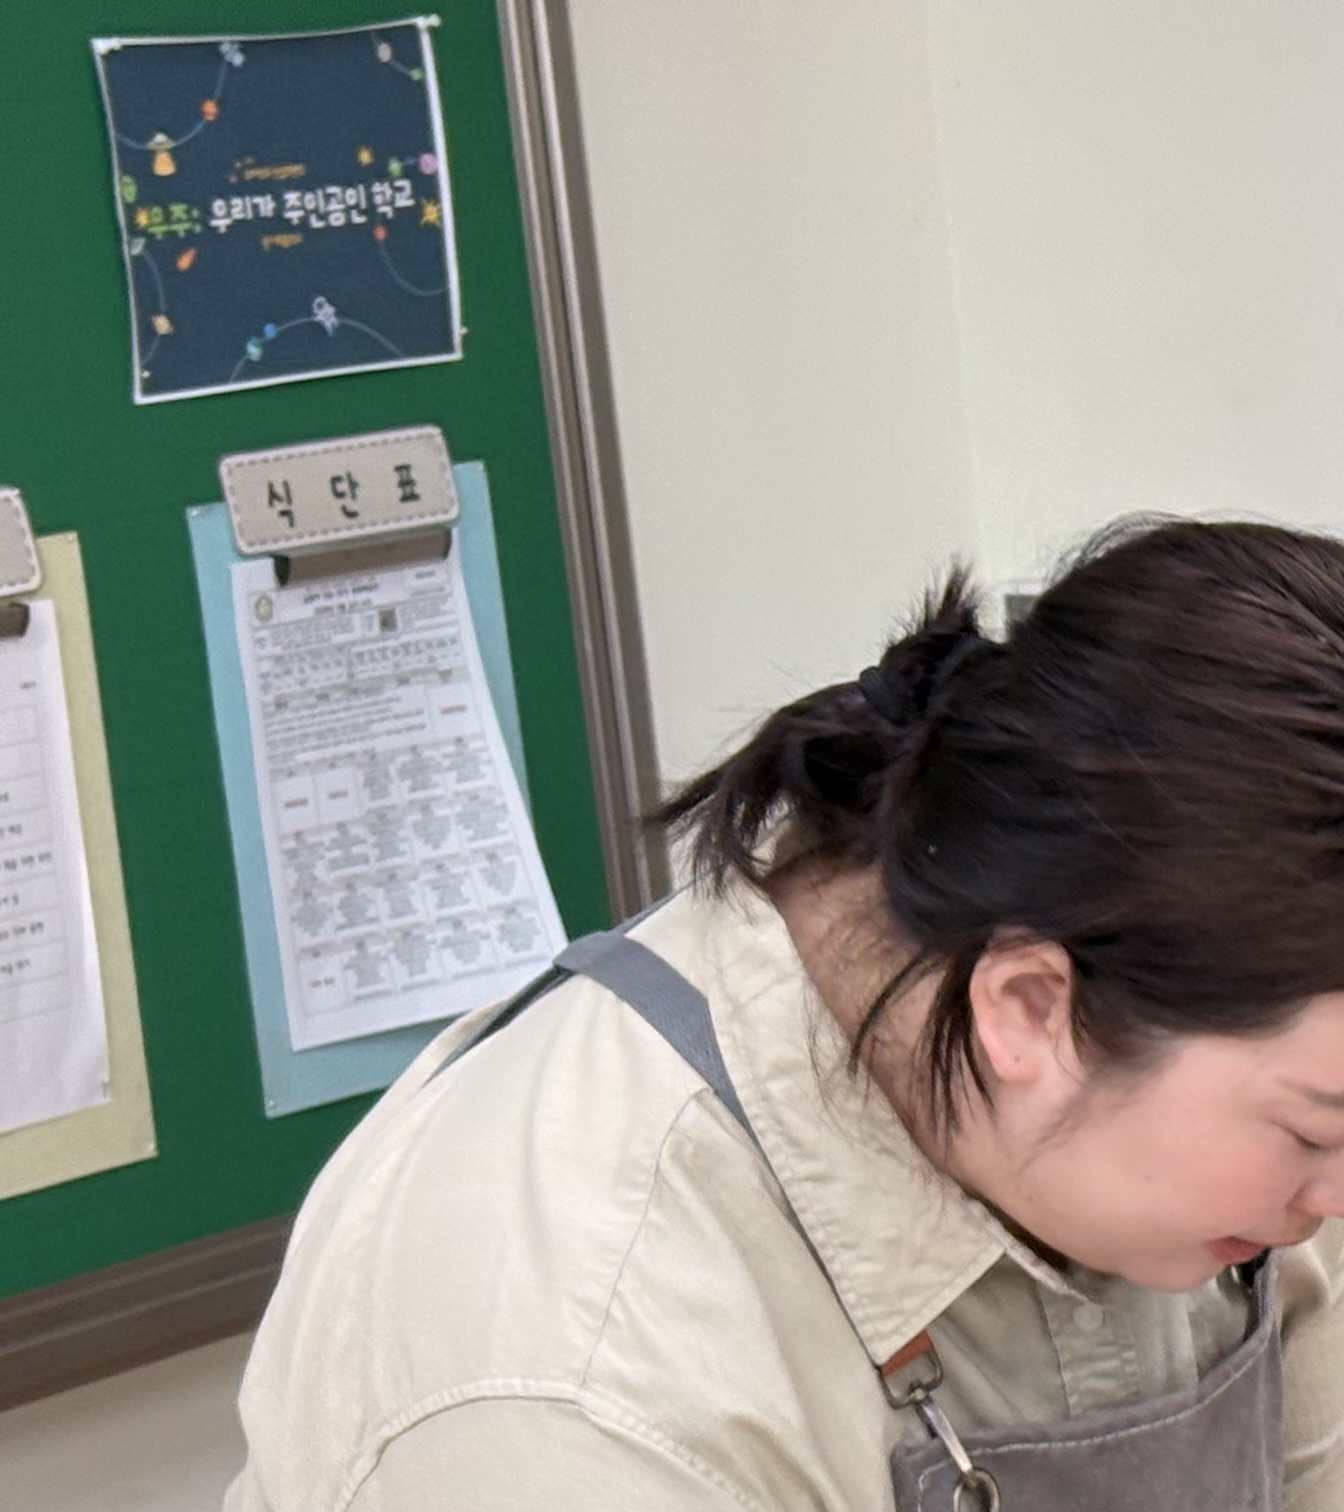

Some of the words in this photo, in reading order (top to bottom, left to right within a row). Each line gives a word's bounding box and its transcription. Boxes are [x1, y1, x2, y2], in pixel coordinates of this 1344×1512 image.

[208, 194, 276, 235] 우리가
[283, 184, 369, 230] 주인공인
[371, 178, 415, 220] 학교
